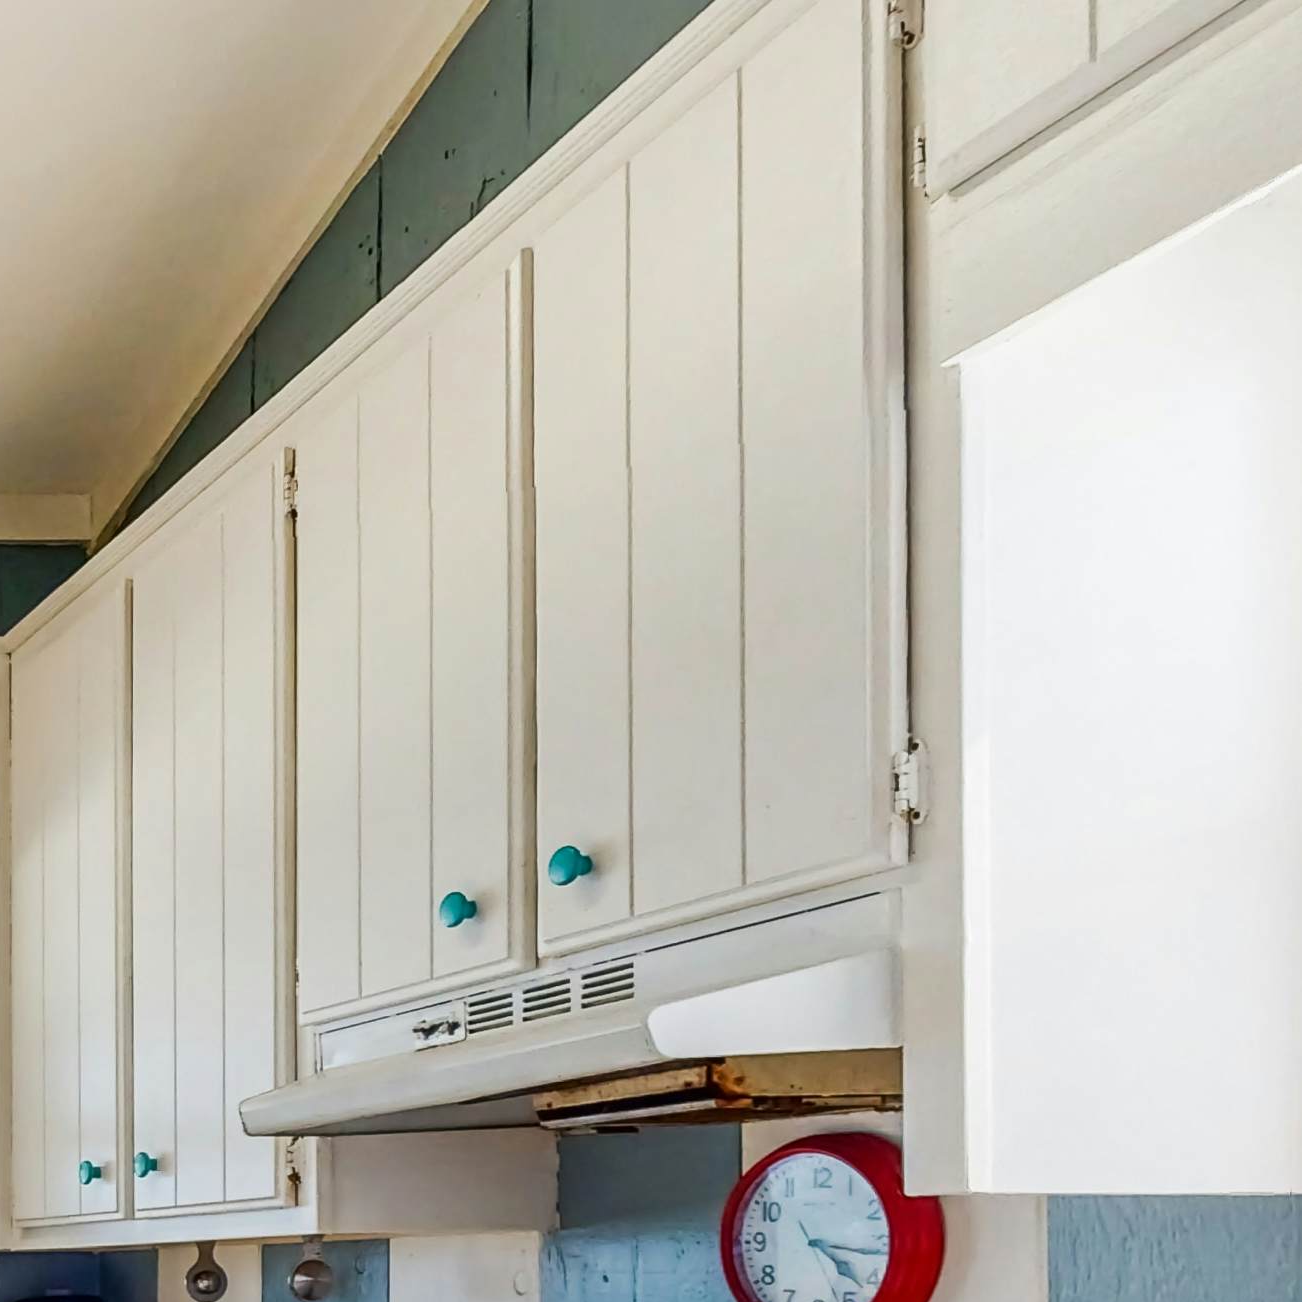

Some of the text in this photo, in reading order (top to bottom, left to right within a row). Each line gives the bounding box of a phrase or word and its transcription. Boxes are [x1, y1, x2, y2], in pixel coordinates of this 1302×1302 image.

[785, 1177, 795, 1198] 11
[813, 1167, 833, 1188] 12
[762, 1201, 781, 1222] 10
[867, 1199, 882, 1220] 2
[753, 1232, 766, 1252] 9
[761, 1265, 775, 1285] 8
[866, 1268, 881, 1286] 4
